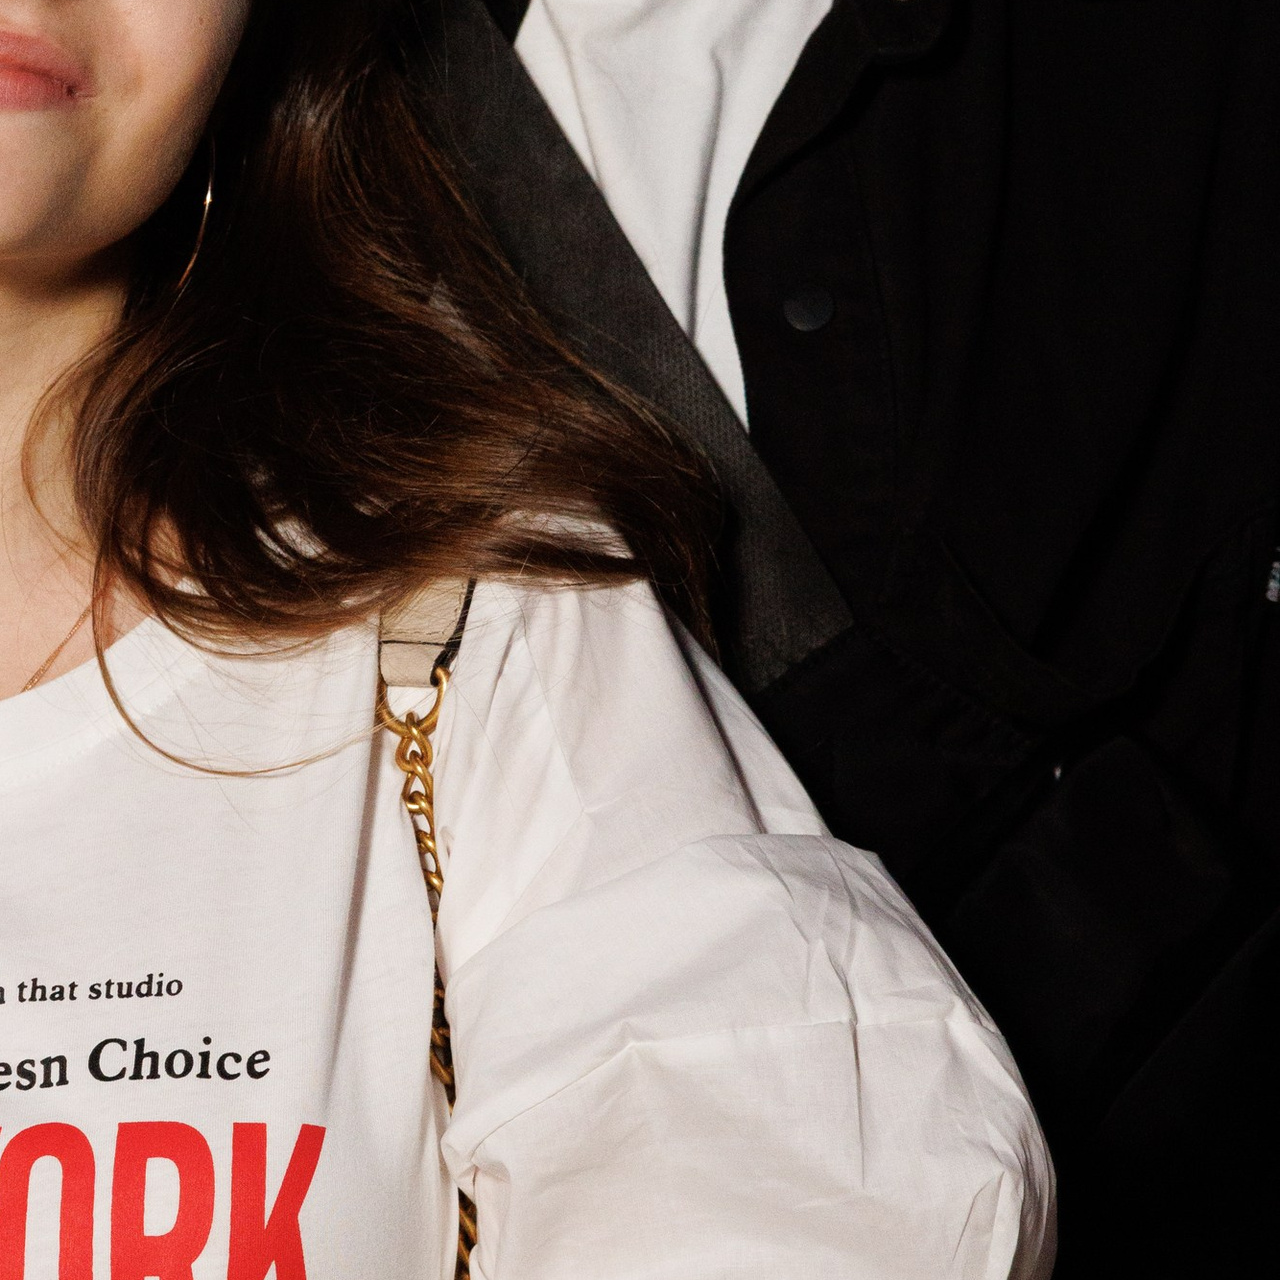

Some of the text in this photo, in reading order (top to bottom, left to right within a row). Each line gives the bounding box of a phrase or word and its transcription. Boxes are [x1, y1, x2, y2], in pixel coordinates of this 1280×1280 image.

[18, 977, 79, 1003] that
[88, 972, 184, 1001] studio
[88, 1035, 271, 1083] Choice
